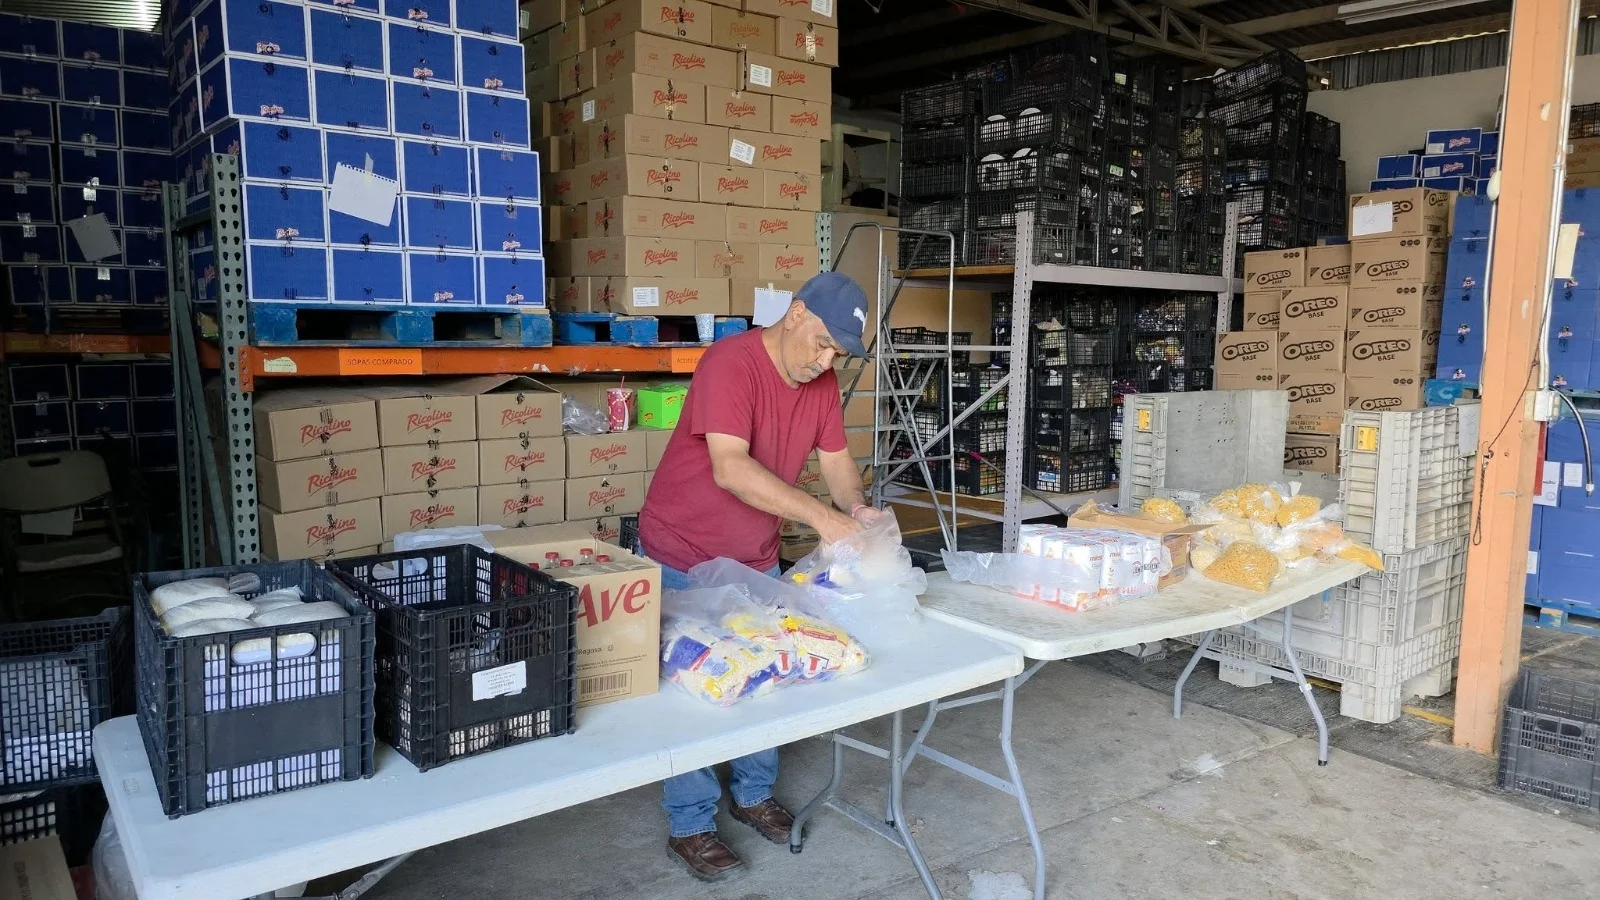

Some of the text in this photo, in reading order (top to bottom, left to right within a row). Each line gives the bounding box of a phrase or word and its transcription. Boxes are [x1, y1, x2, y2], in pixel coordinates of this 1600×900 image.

[672, 53, 706, 70] Ricolino
[777, 71, 806, 87] Ricolino
[725, 102, 756, 118] Ricolino
[665, 132, 698, 151] Ricolino
[762, 144, 793, 162] Ricolino
[718, 176, 749, 193] Ricolino
[779, 182, 808, 198] Ricolino
[661, 211, 696, 230] Ricolino
[759, 218, 789, 236] Ricolino
[644, 248, 679, 267] Ricolino
[774, 253, 804, 271] Ricolino
[1257, 269, 1291, 285] OREO
[1321, 265, 1350, 280] ORE
[1366, 260, 1409, 276] OREO
[665, 286, 699, 306] Ricolino
[1285, 297, 1338, 318] OREO
[1363, 307, 1406, 323] OREO
[1222, 341, 1269, 360] OREO
[1283, 340, 1335, 360] OREO
[1352, 340, 1411, 360] OREO
[347, 358, 413, 366] SOPAS COMPRADO
[1287, 383, 1335, 402] OREO
[1306, 396, 1322, 404] BASE
[1361, 397, 1402, 411] OREO
[406, 409, 452, 434] Ricolino
[502, 405, 542, 428] Ricolino
[300, 419, 352, 446] Ricolino
[589, 443, 628, 465] Ricolino
[589, 487, 626, 510] Ricolino
